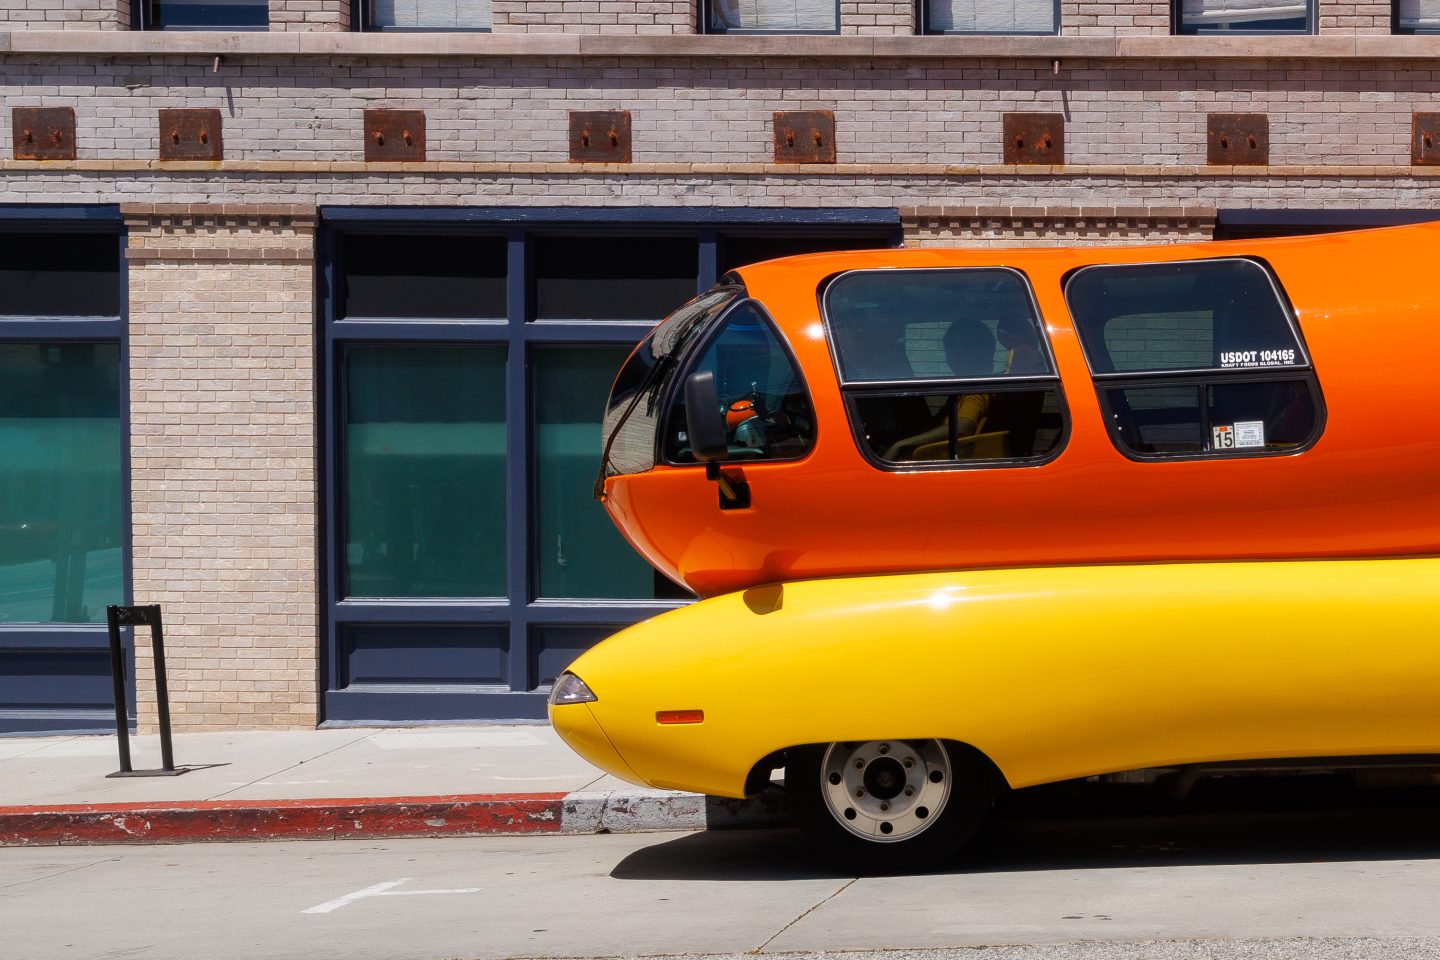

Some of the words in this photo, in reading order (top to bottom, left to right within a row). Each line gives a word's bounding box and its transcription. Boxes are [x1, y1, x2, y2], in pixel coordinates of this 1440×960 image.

[1220, 351, 1257, 363] USDOT
[1260, 349, 1295, 361] 104165
[1216, 431, 1233, 447] 15
